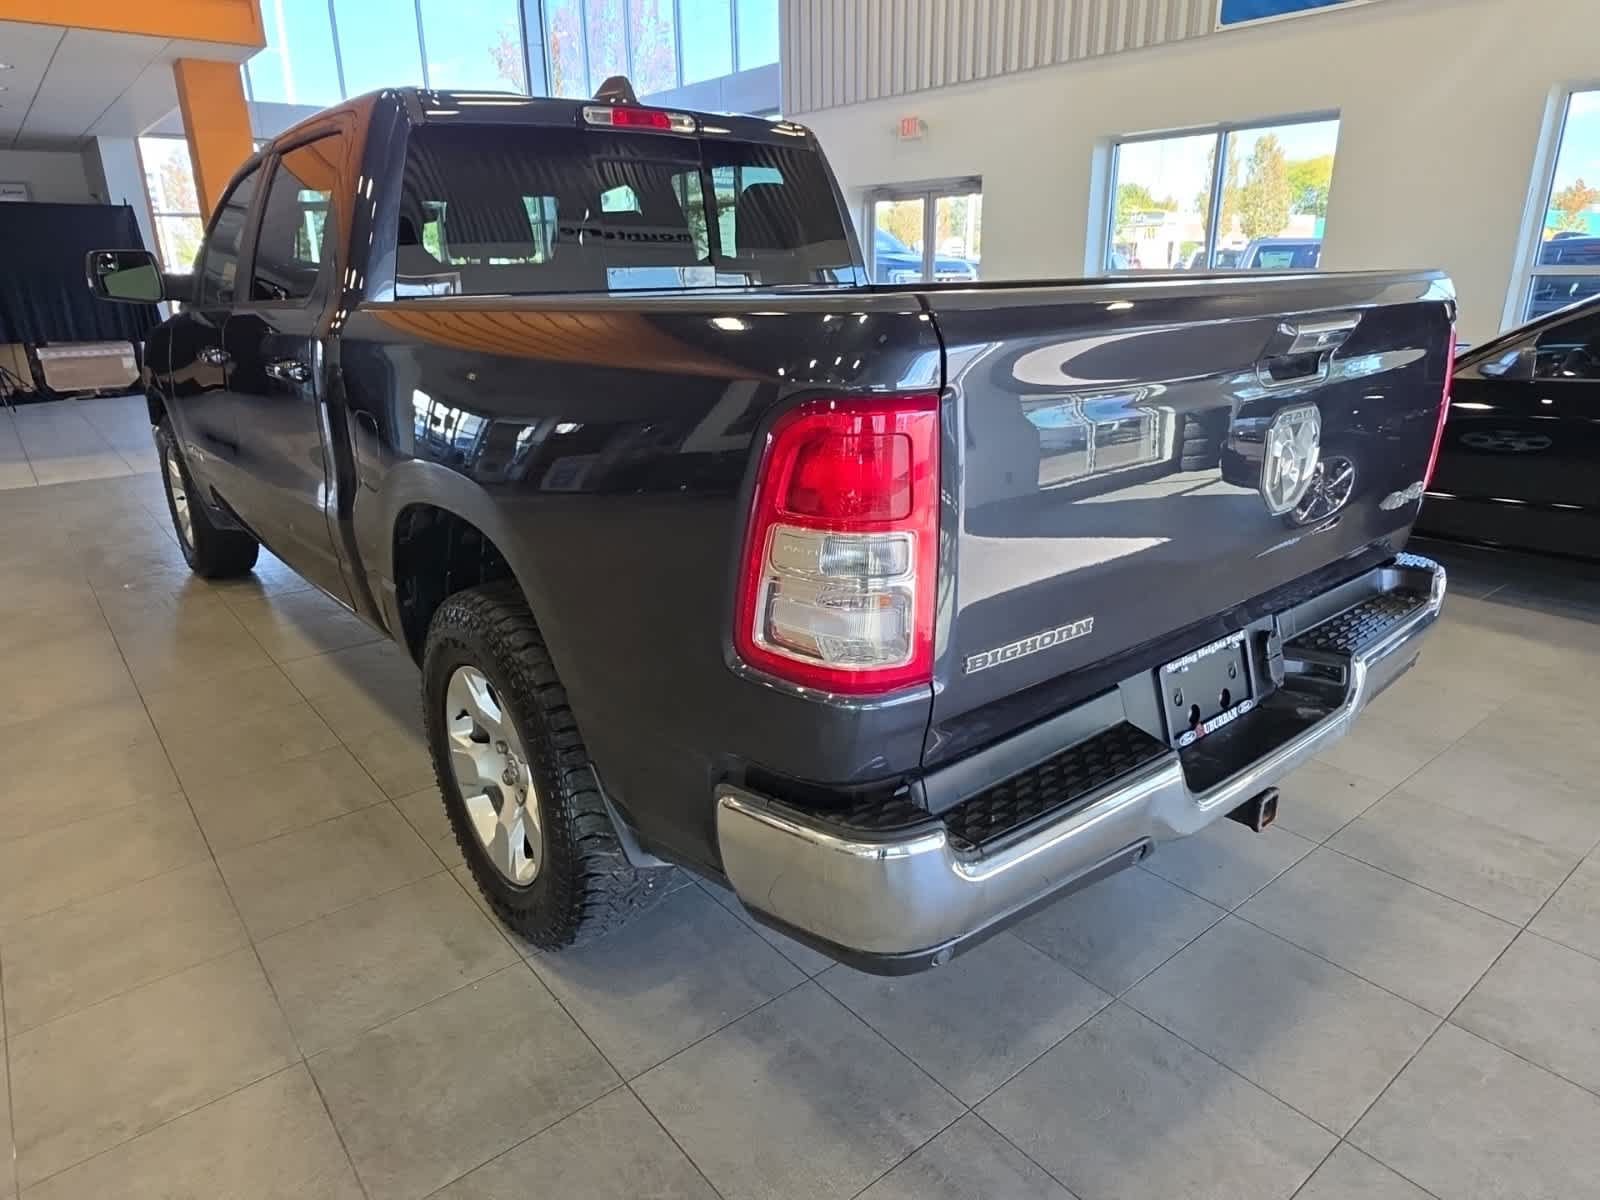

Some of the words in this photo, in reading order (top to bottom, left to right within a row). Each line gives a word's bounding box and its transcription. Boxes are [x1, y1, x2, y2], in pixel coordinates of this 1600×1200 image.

[900, 119, 921, 137] EXIT
[965, 617, 1094, 674] BIGHORN
[1166, 650, 1198, 673] Sterling
[1198, 637, 1227, 658] Heights
